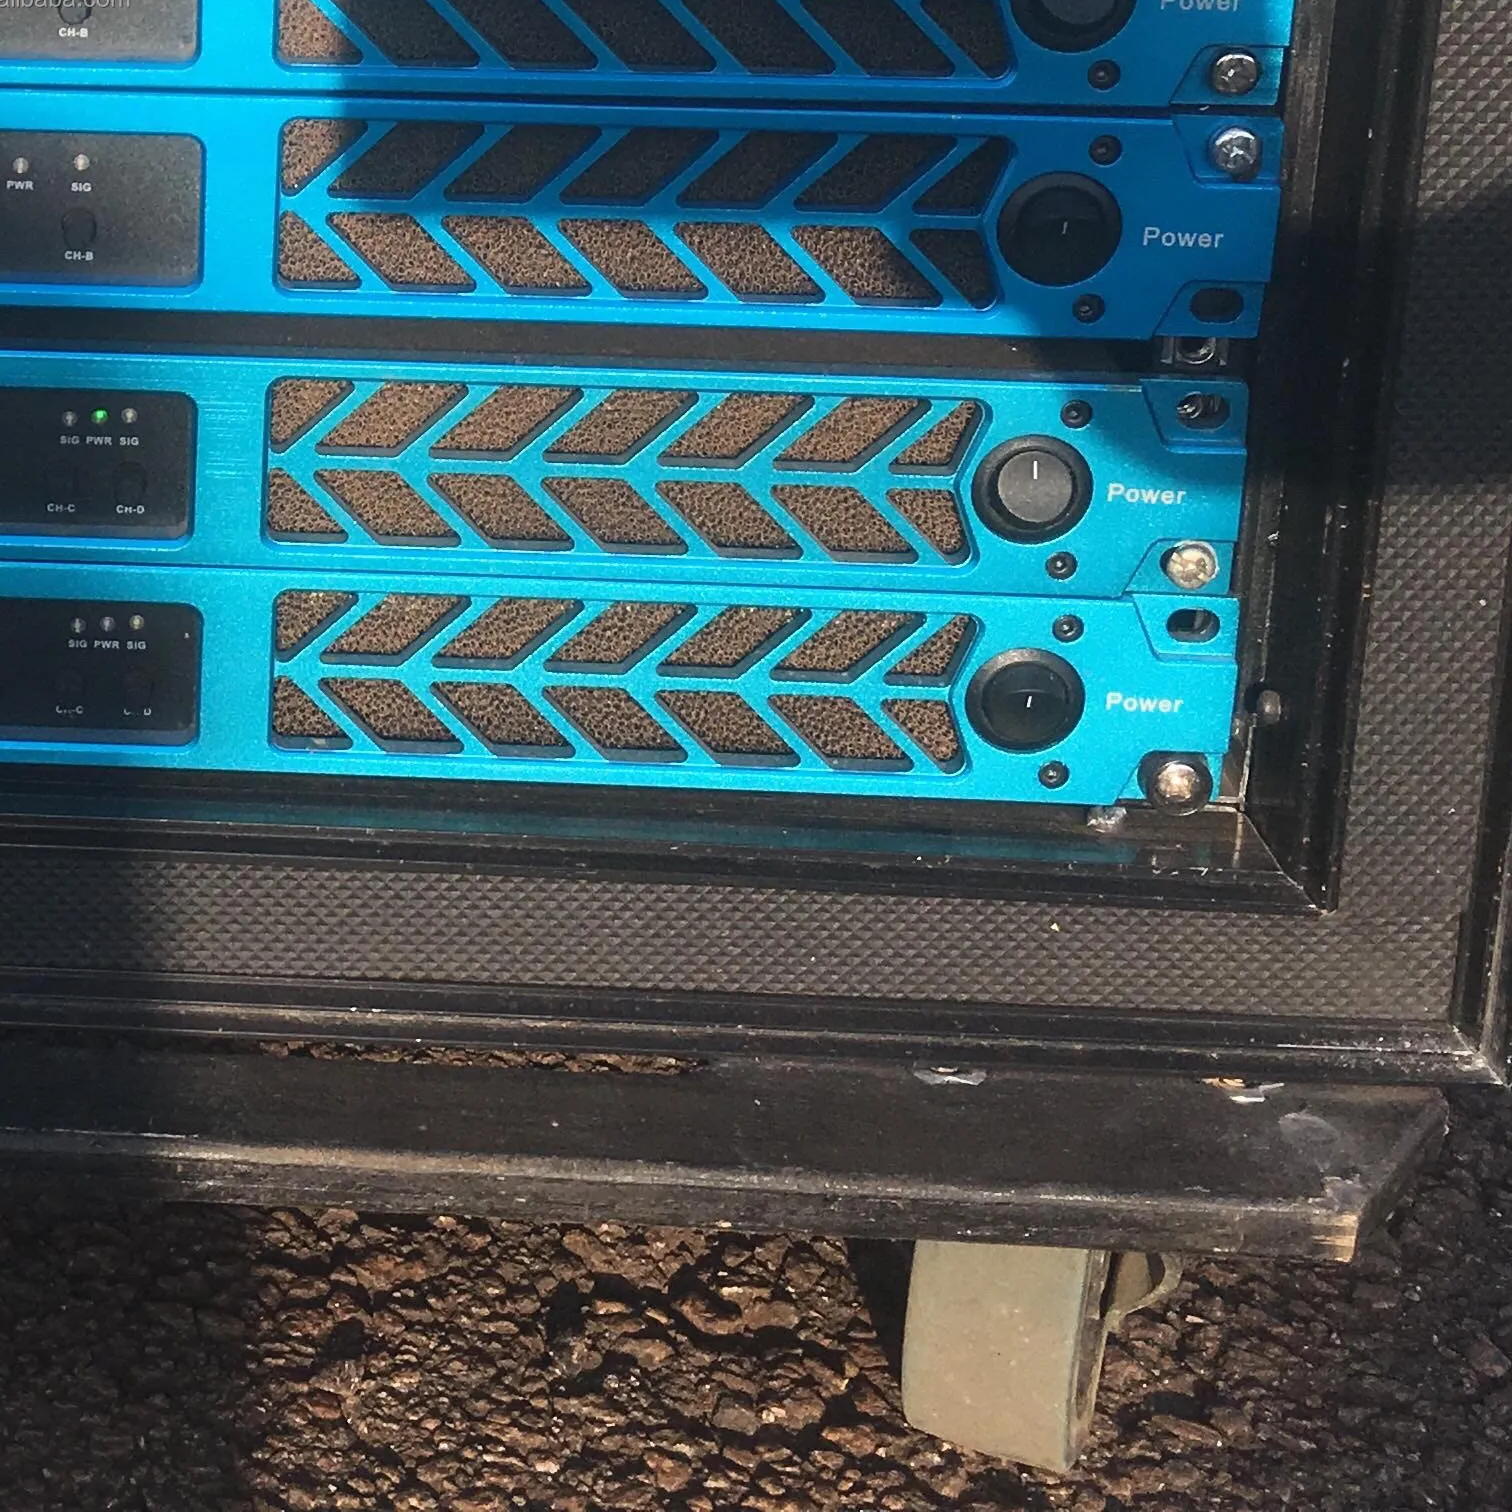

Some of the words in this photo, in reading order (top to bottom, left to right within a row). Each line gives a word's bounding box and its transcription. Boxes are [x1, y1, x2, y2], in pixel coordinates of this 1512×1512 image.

[6, 180, 34, 191] PWR
[71, 182, 92, 192] SIG
[1142, 226, 1224, 249] Power
[60, 435, 80, 445] SIG
[86, 436, 112, 446] PWR
[120, 437, 139, 446] SIG
[1107, 482, 1187, 505] Power
[68, 639, 88, 649] SIG
[93, 640, 120, 649] PWR
[127, 641, 147, 650] SIG
[1105, 692, 1184, 713] Power
